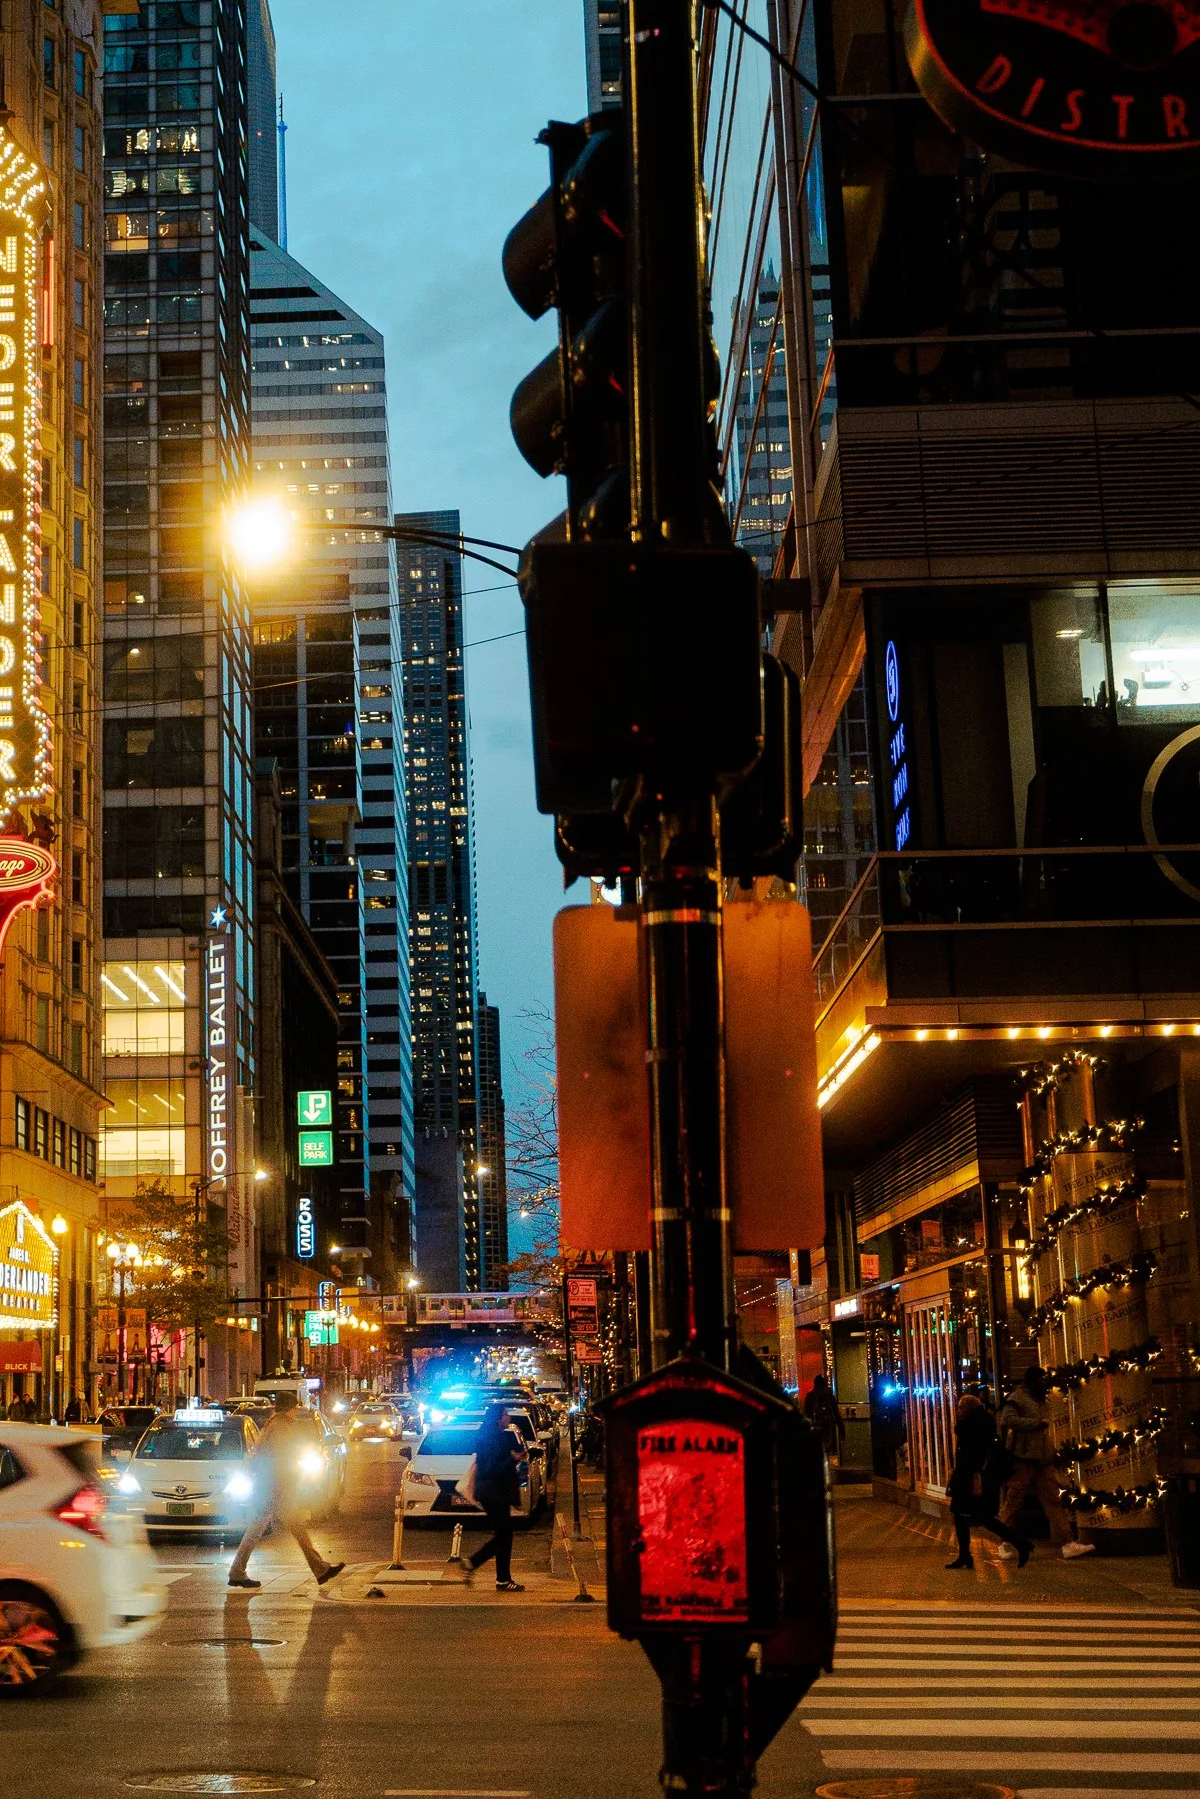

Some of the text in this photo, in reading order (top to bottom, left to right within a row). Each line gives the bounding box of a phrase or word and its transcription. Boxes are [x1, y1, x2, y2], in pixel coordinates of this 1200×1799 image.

[209, 939, 227, 1188] JOFFREY BALLET
[304, 1142, 325, 1151] SELF
[304, 1151, 327, 1159] PARK
[299, 1198, 312, 1252] ROSS
[640, 1436, 738, 1453] FIRE ALARM
